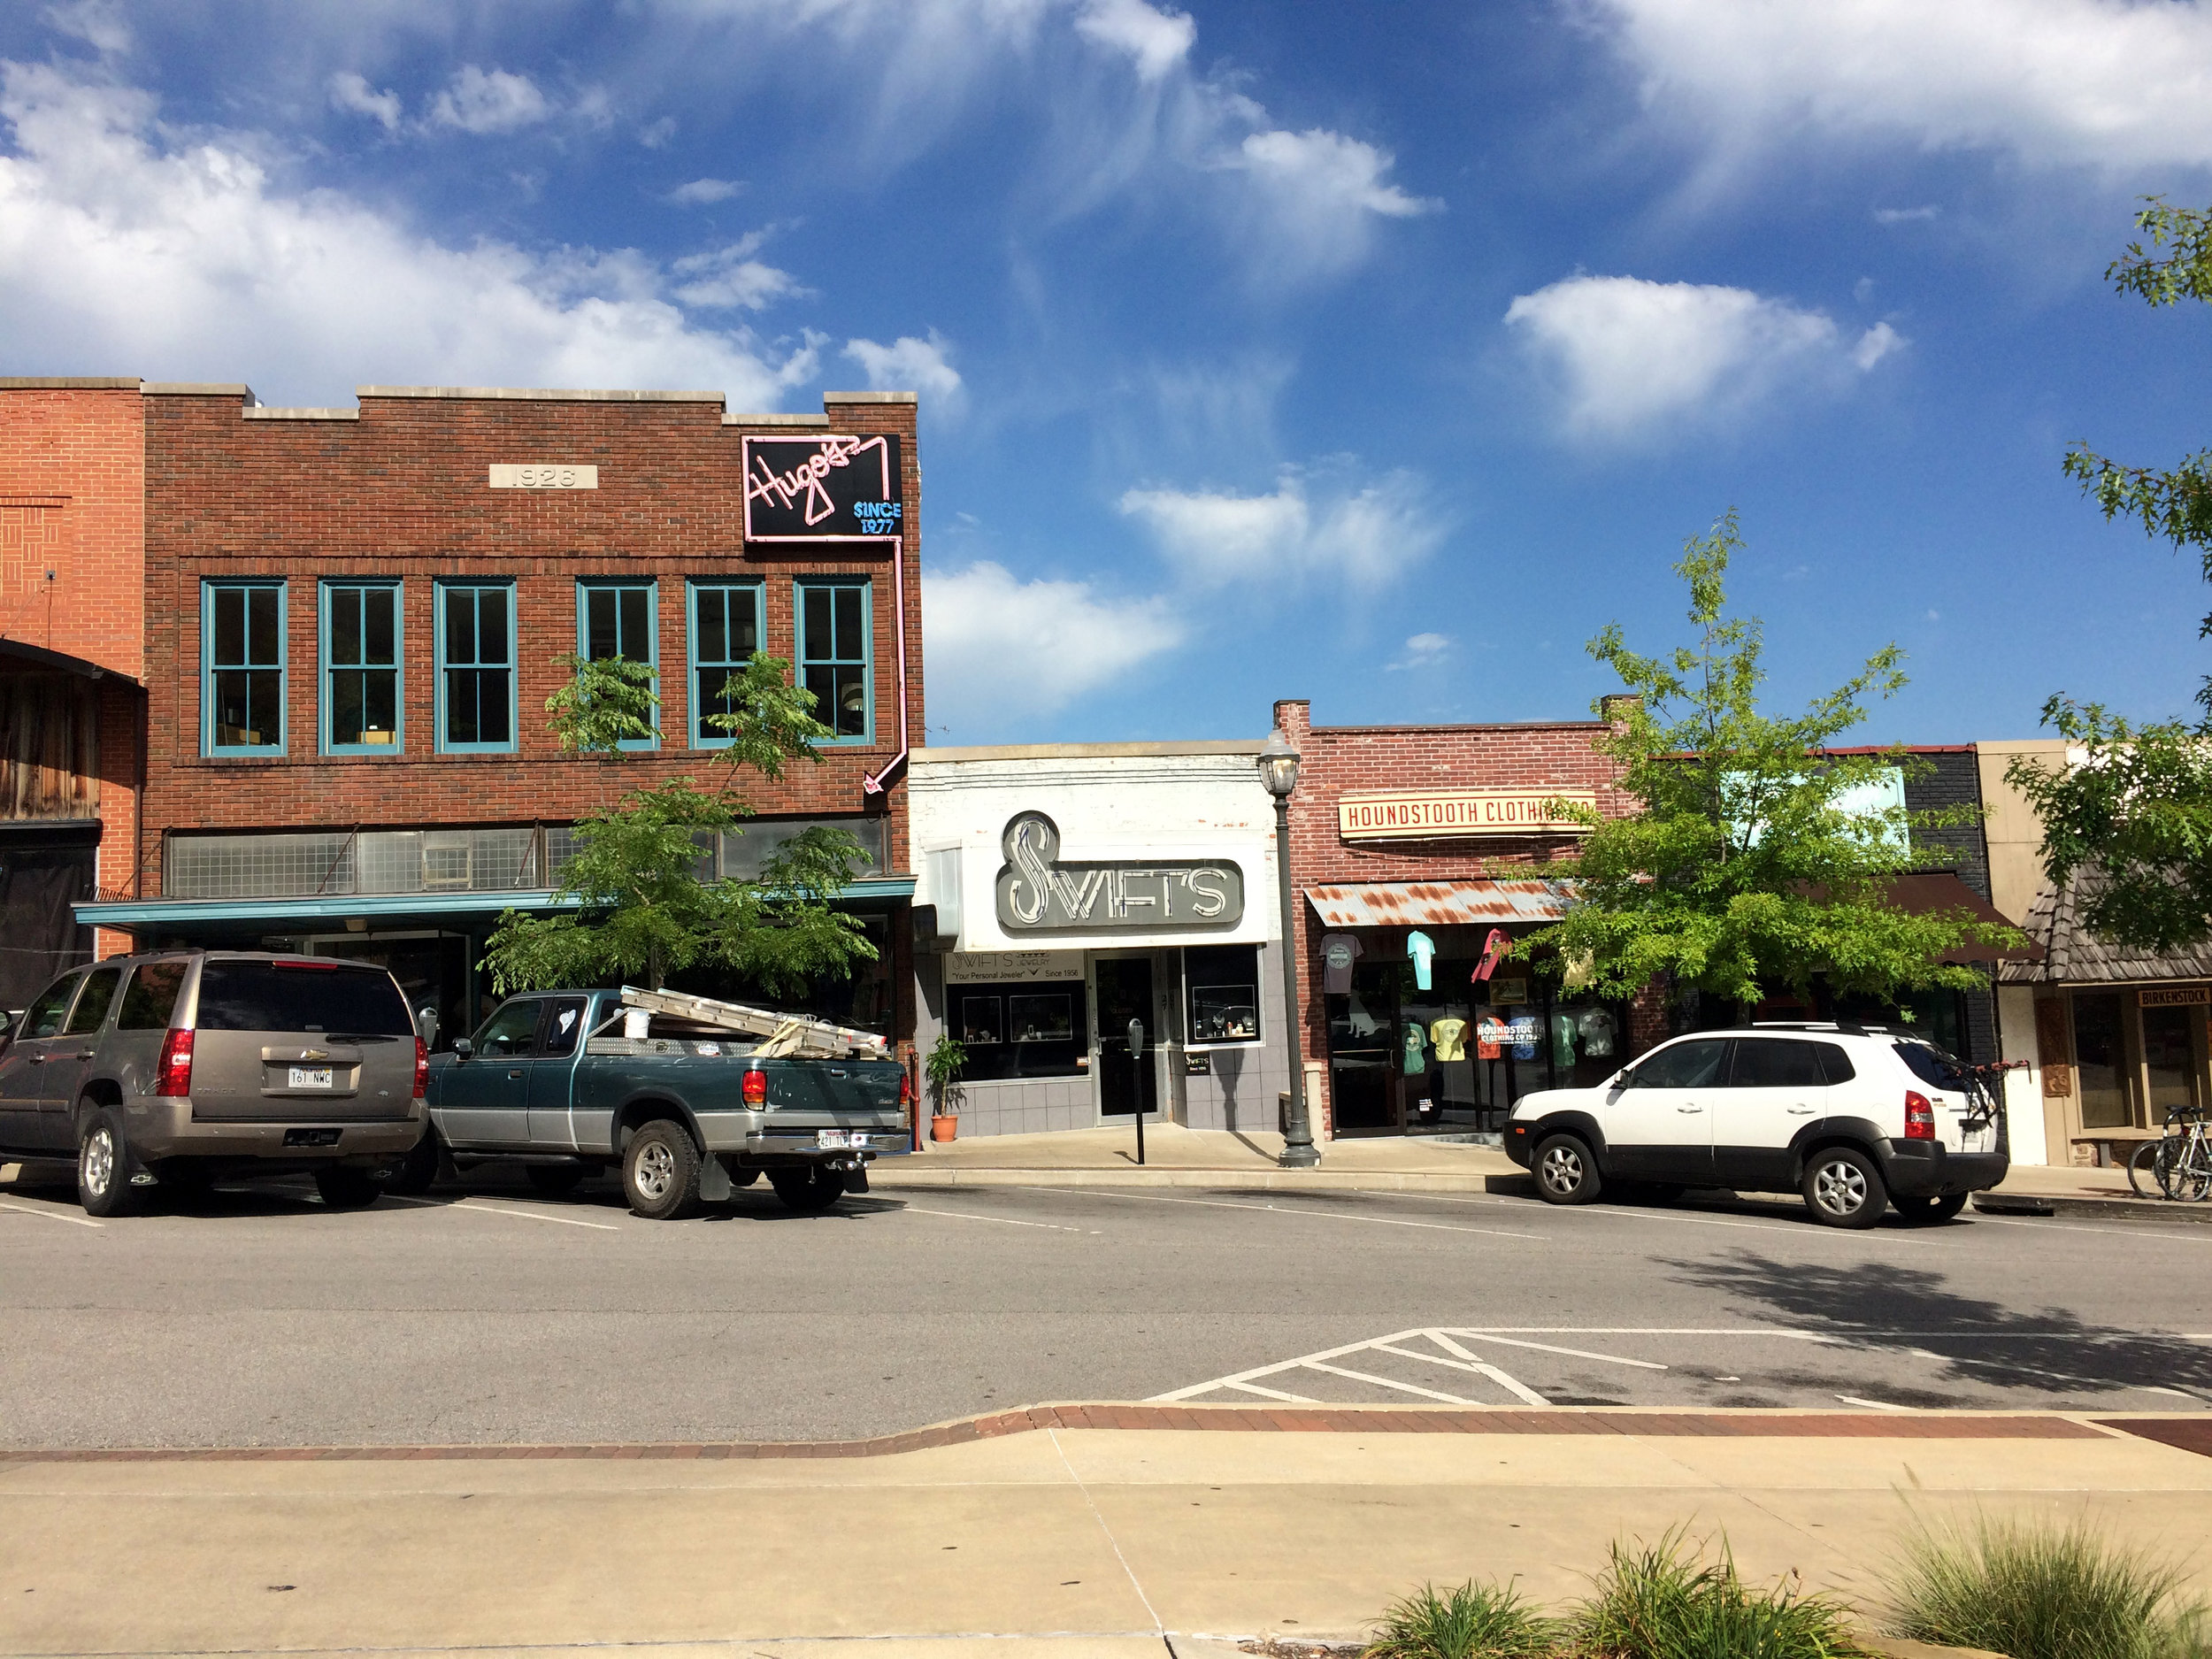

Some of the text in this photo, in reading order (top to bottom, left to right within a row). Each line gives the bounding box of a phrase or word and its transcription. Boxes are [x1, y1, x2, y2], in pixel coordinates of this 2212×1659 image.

[512, 466, 575, 487] 1926
[749, 441, 855, 526] Hugo's
[853, 501, 902, 518] SINCE
[861, 519, 895, 534] 1977
[1348, 803, 1479, 827] HOUNDSTOOTH
[2142, 989, 2207, 1004] BIRKENSTOCK
[1477, 1025, 1545, 1035] HOUNDSTOOTH
